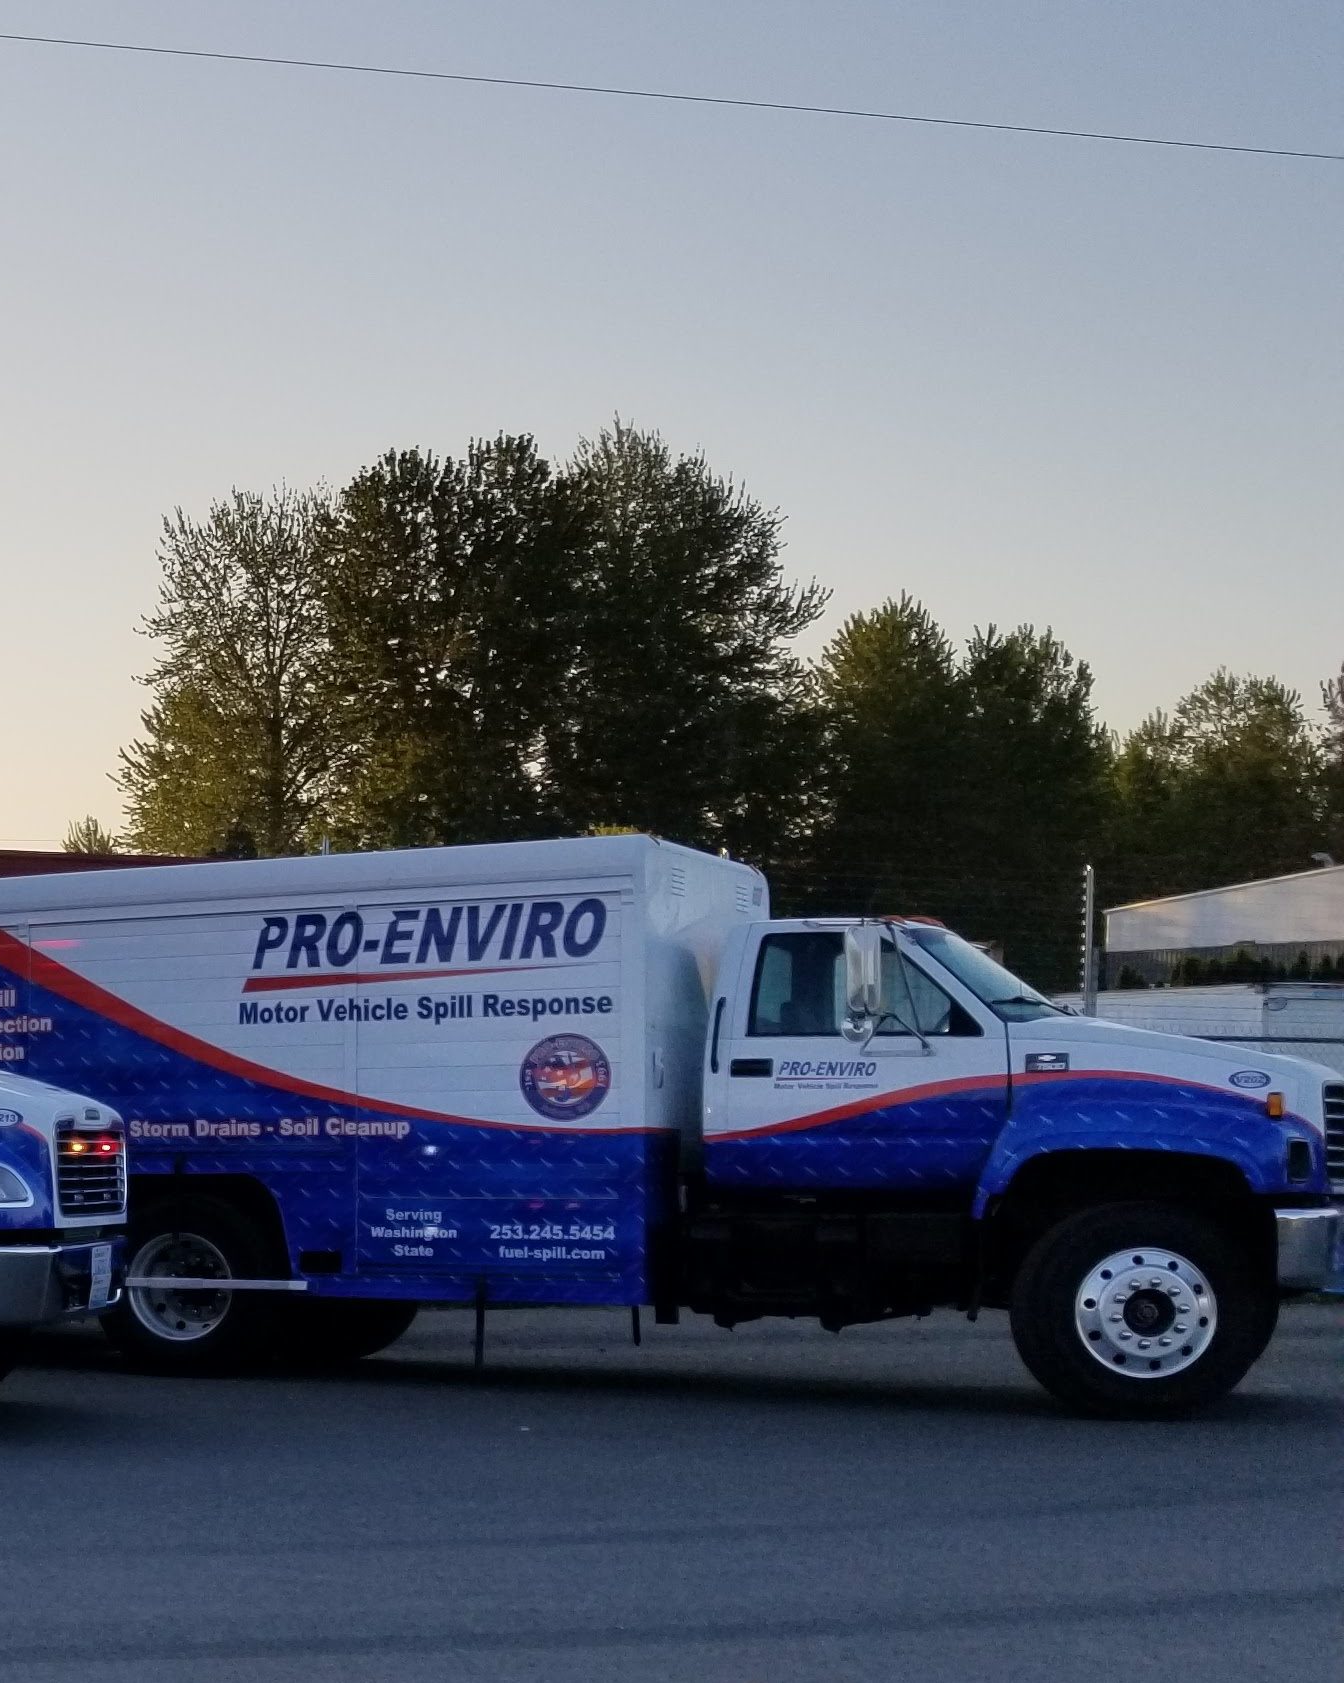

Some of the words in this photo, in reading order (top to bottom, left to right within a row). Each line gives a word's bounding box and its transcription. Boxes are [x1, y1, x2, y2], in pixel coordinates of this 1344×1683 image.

[252, 898, 607, 970] PRO-ENVIRO
[239, 1000, 310, 1025] Motor
[317, 996, 409, 1022] Vehicle
[416, 994, 473, 1024] Spill
[482, 994, 613, 1023] Response
[778, 1061, 878, 1076] PRO-ENVIRO
[129, 1120, 189, 1138] Storm
[195, 1119, 261, 1138] Drains
[280, 1118, 319, 1137] Soil
[325, 1117, 410, 1139] Cleanup
[385, 1208, 443, 1224] Serving
[370, 1226, 458, 1241] Washington
[490, 1225, 615, 1241] 253.245.5454
[394, 1244, 434, 1257] State
[498, 1246, 606, 1261] fuel-spill.com
